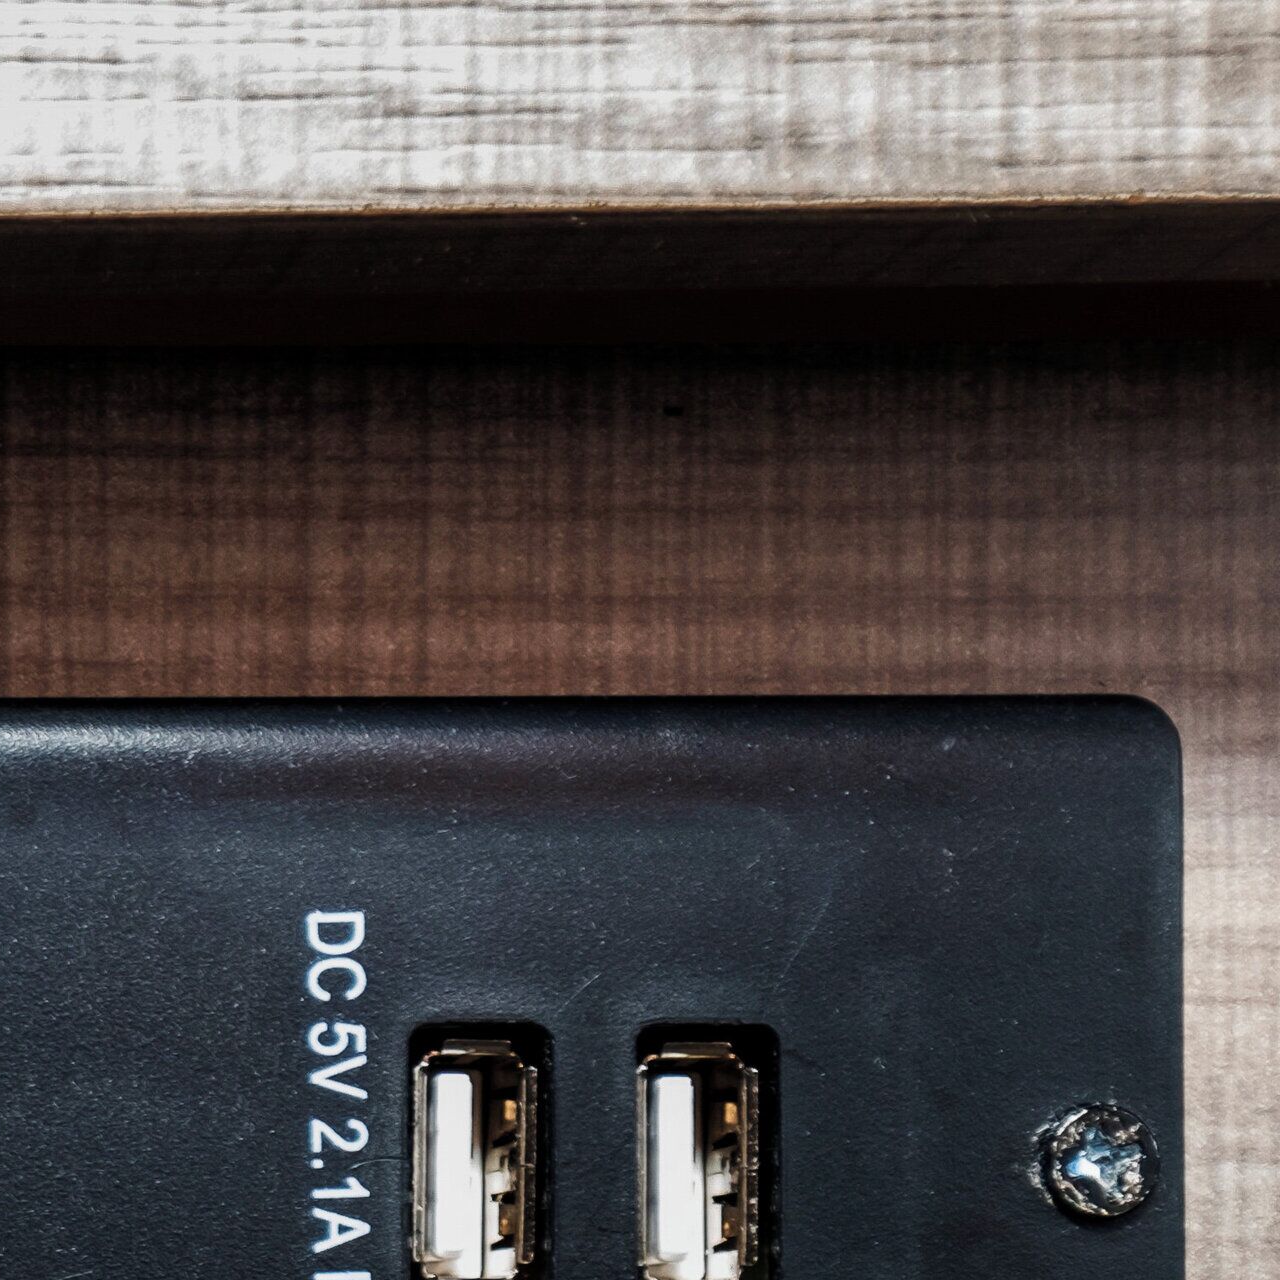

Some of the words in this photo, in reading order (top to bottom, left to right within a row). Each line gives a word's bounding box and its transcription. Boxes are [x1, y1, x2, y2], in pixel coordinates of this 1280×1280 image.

[304, 909, 368, 1001] DC
[307, 1021, 369, 1100] 5V
[309, 1118, 372, 1254] 2.1A
